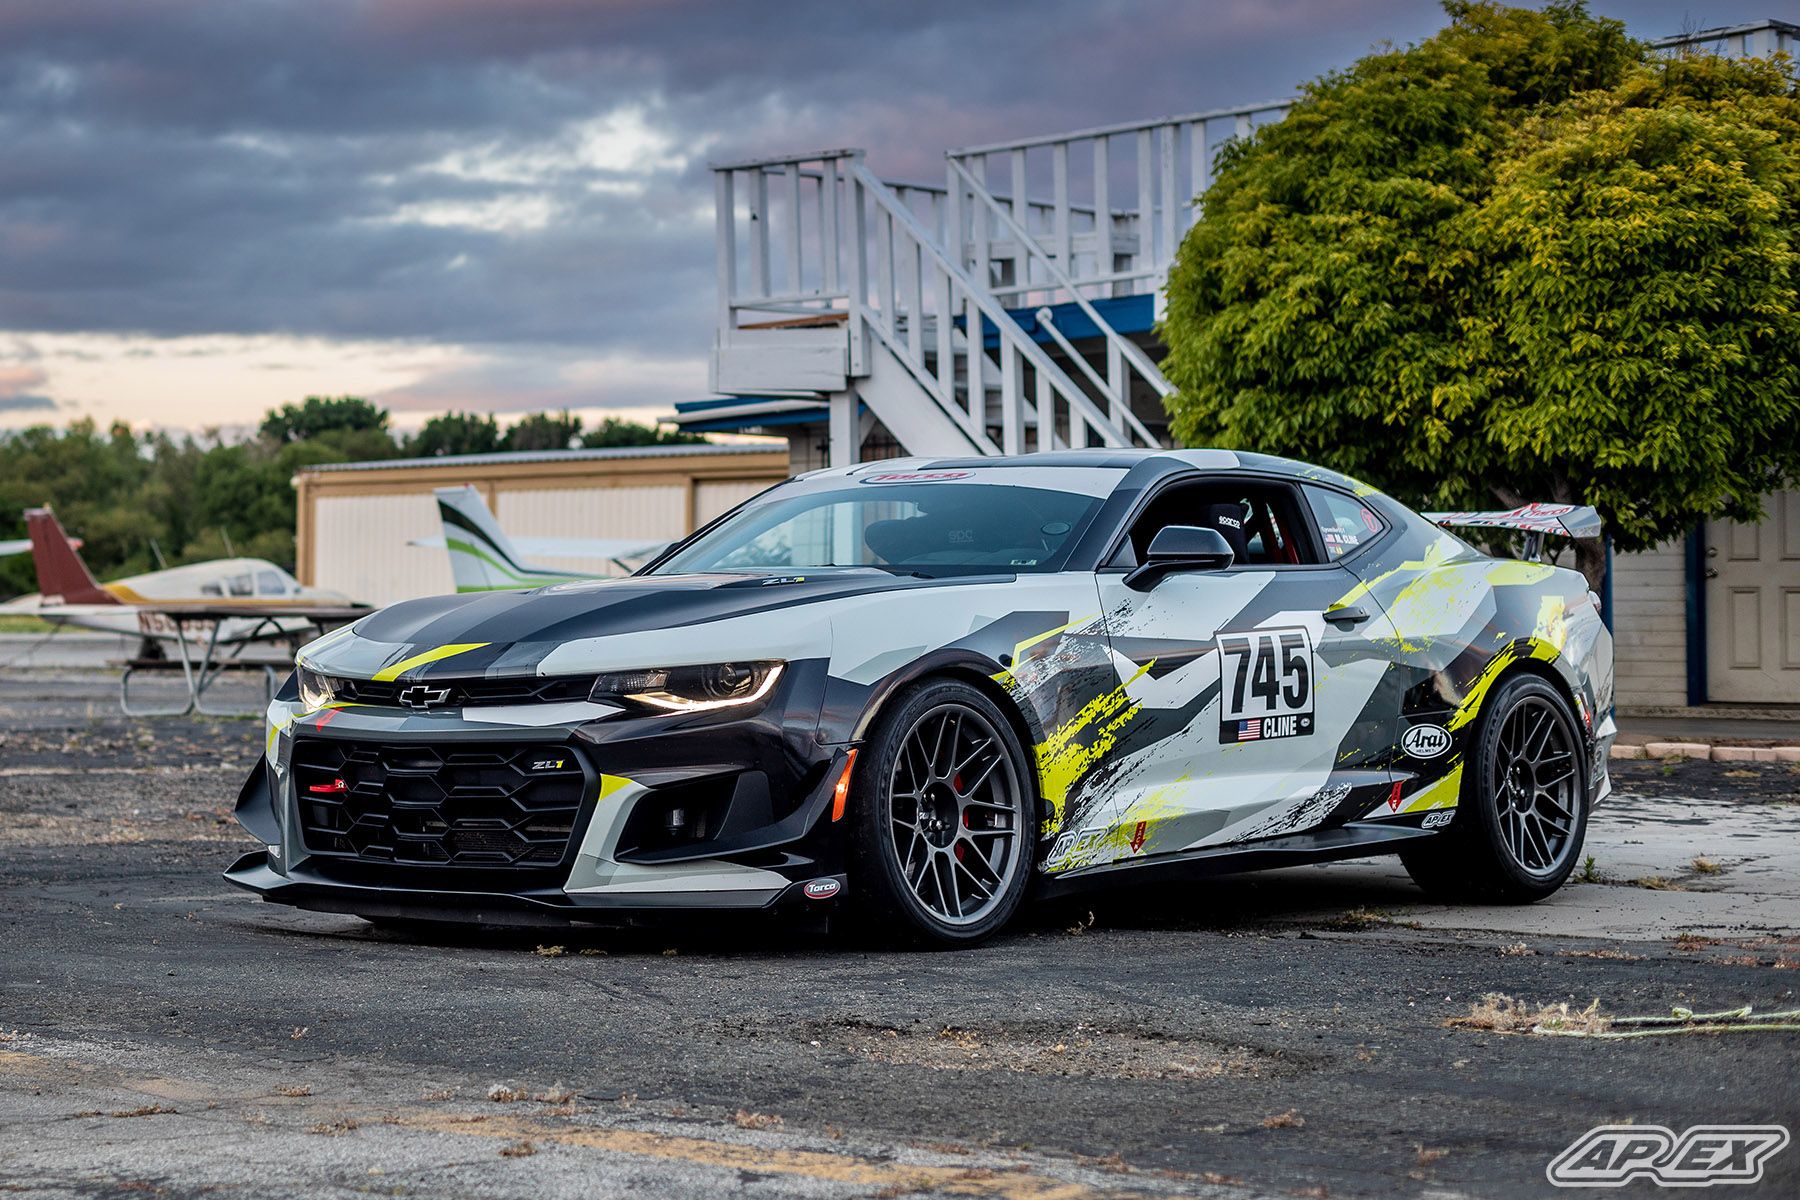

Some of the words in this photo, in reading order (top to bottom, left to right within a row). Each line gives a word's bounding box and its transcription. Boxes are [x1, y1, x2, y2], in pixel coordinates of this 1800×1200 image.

[1221, 633, 1309, 714] 745
[1263, 715, 1297, 738] CLINE
[1406, 729, 1444, 749] Arai
[532, 760, 564, 769] ZL1
[809, 883, 836, 892] Torco
